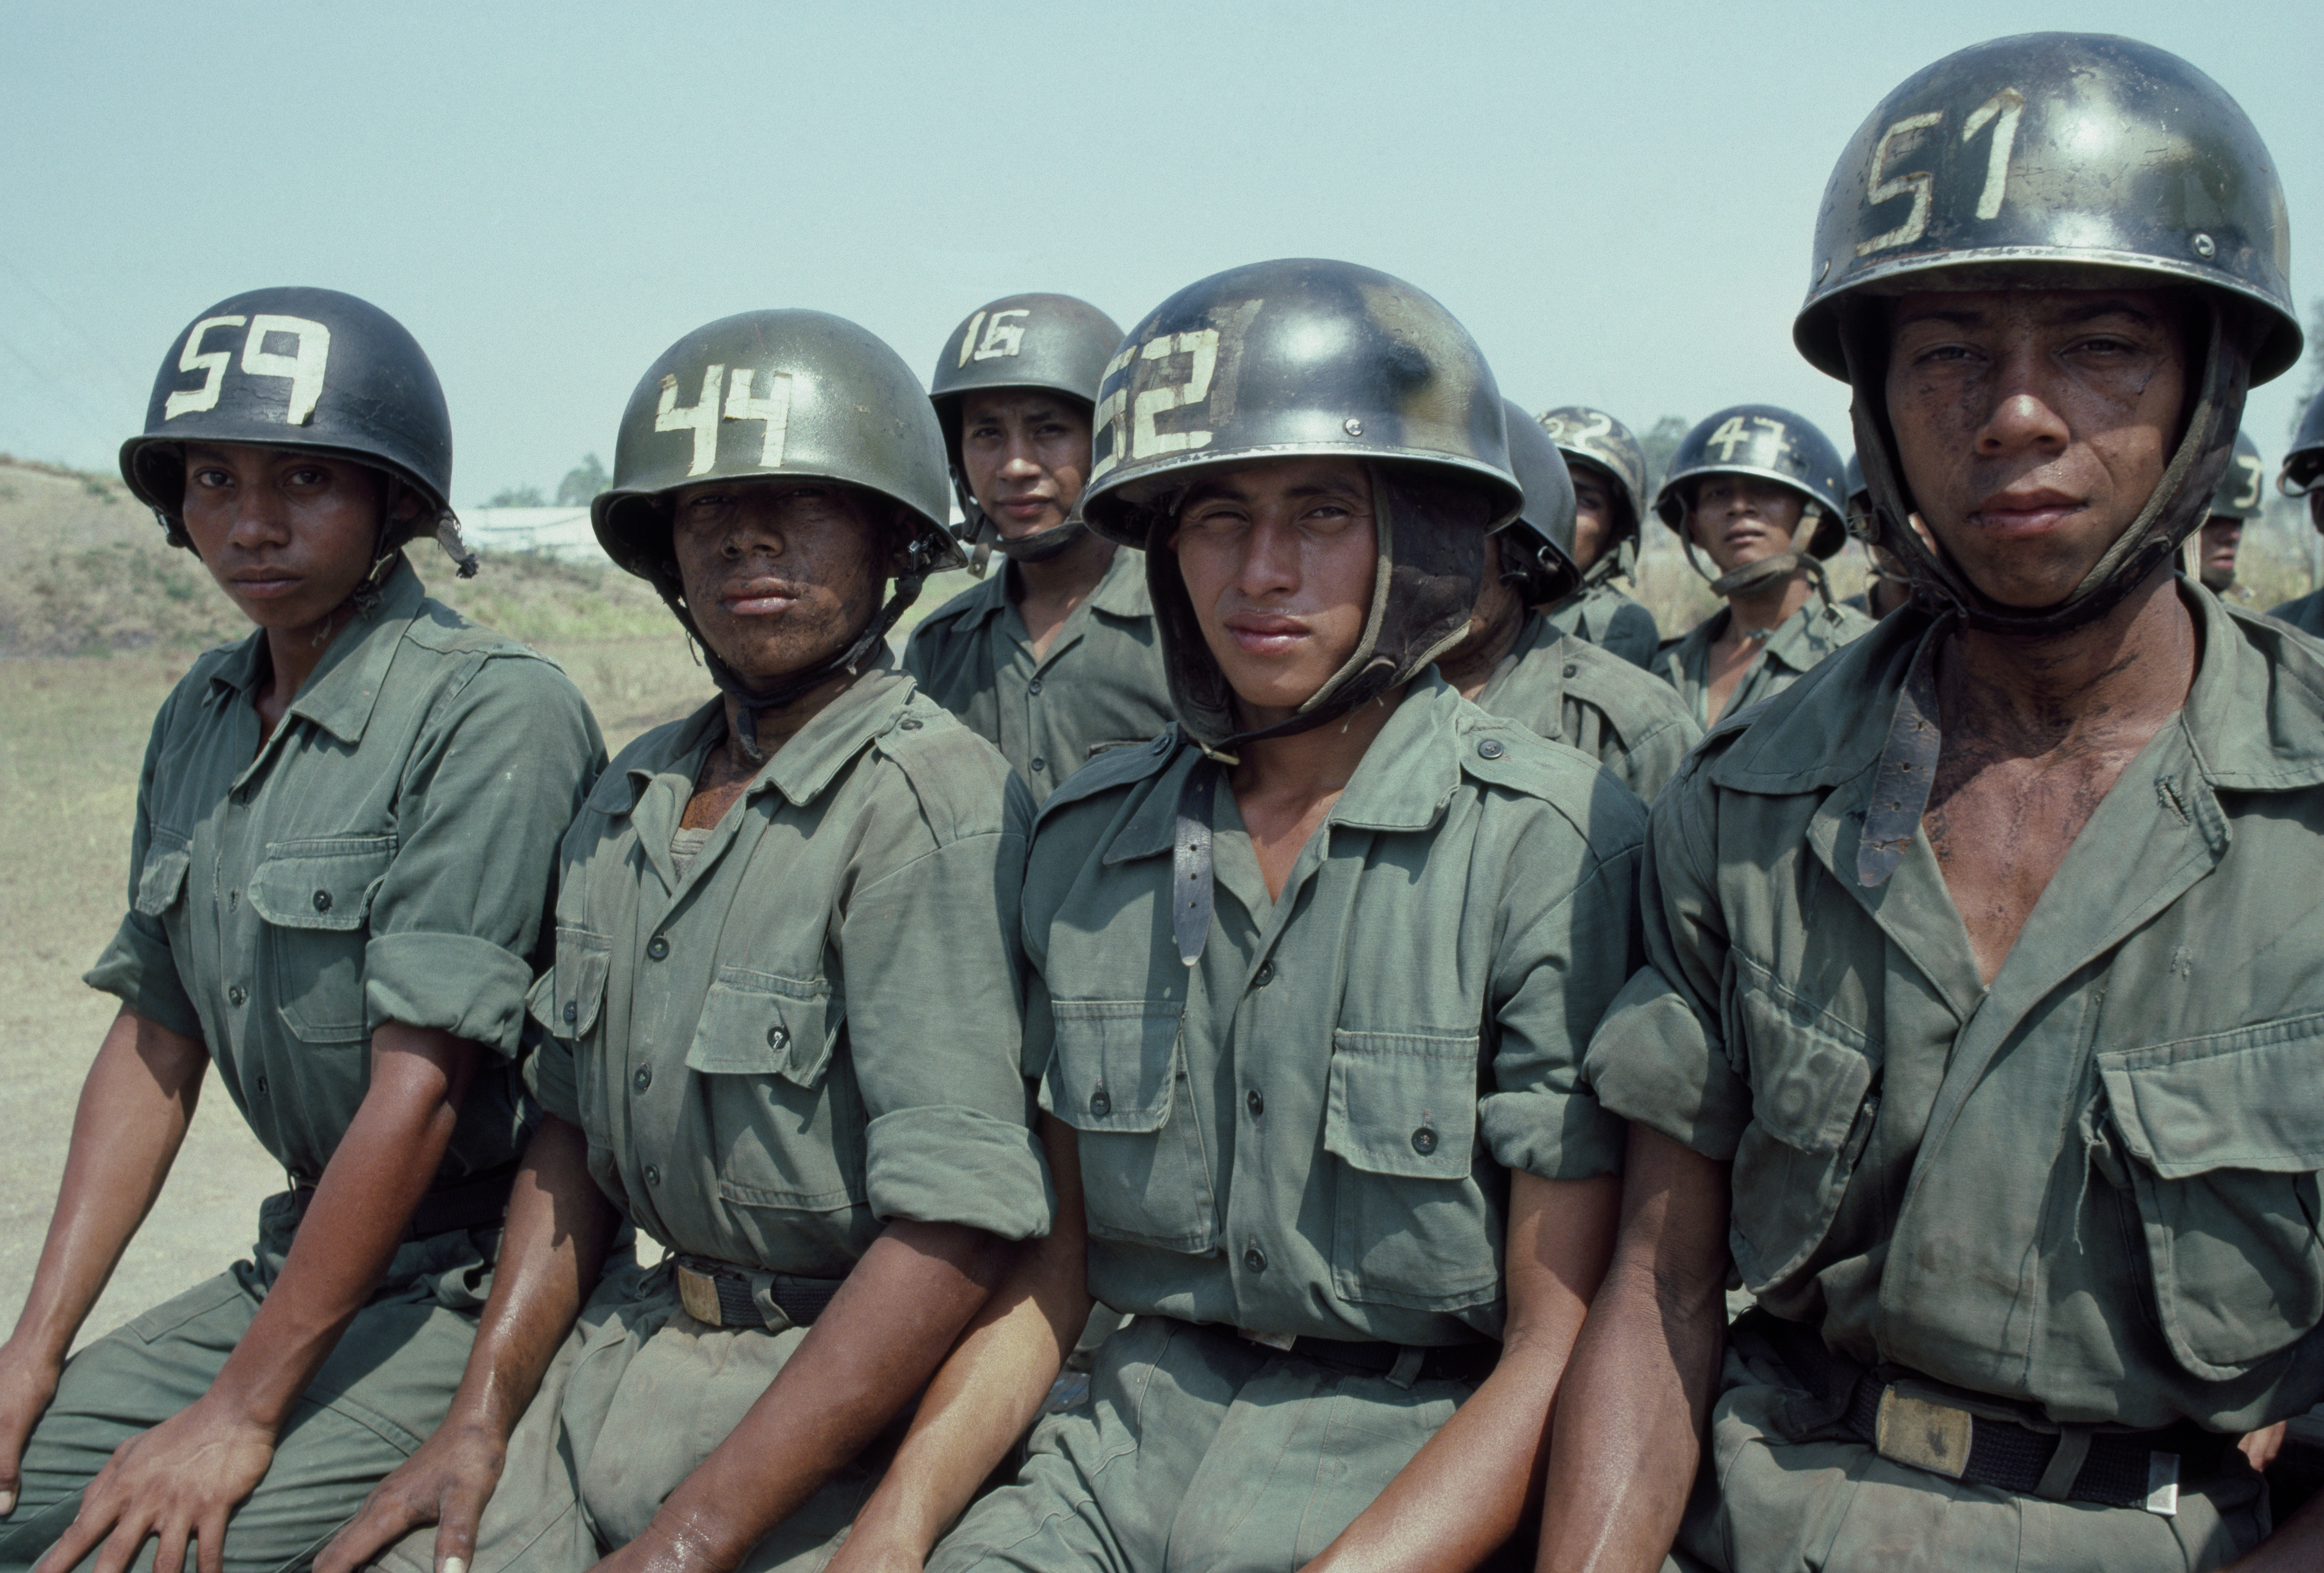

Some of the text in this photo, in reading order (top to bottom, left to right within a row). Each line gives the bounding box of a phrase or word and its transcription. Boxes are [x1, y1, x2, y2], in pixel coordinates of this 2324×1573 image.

[1856, 87, 2023, 257] 51
[165, 315, 331, 425] 59
[958, 309, 1030, 369] 16
[655, 364, 793, 476] 44
[1706, 416, 1791, 469] 47
